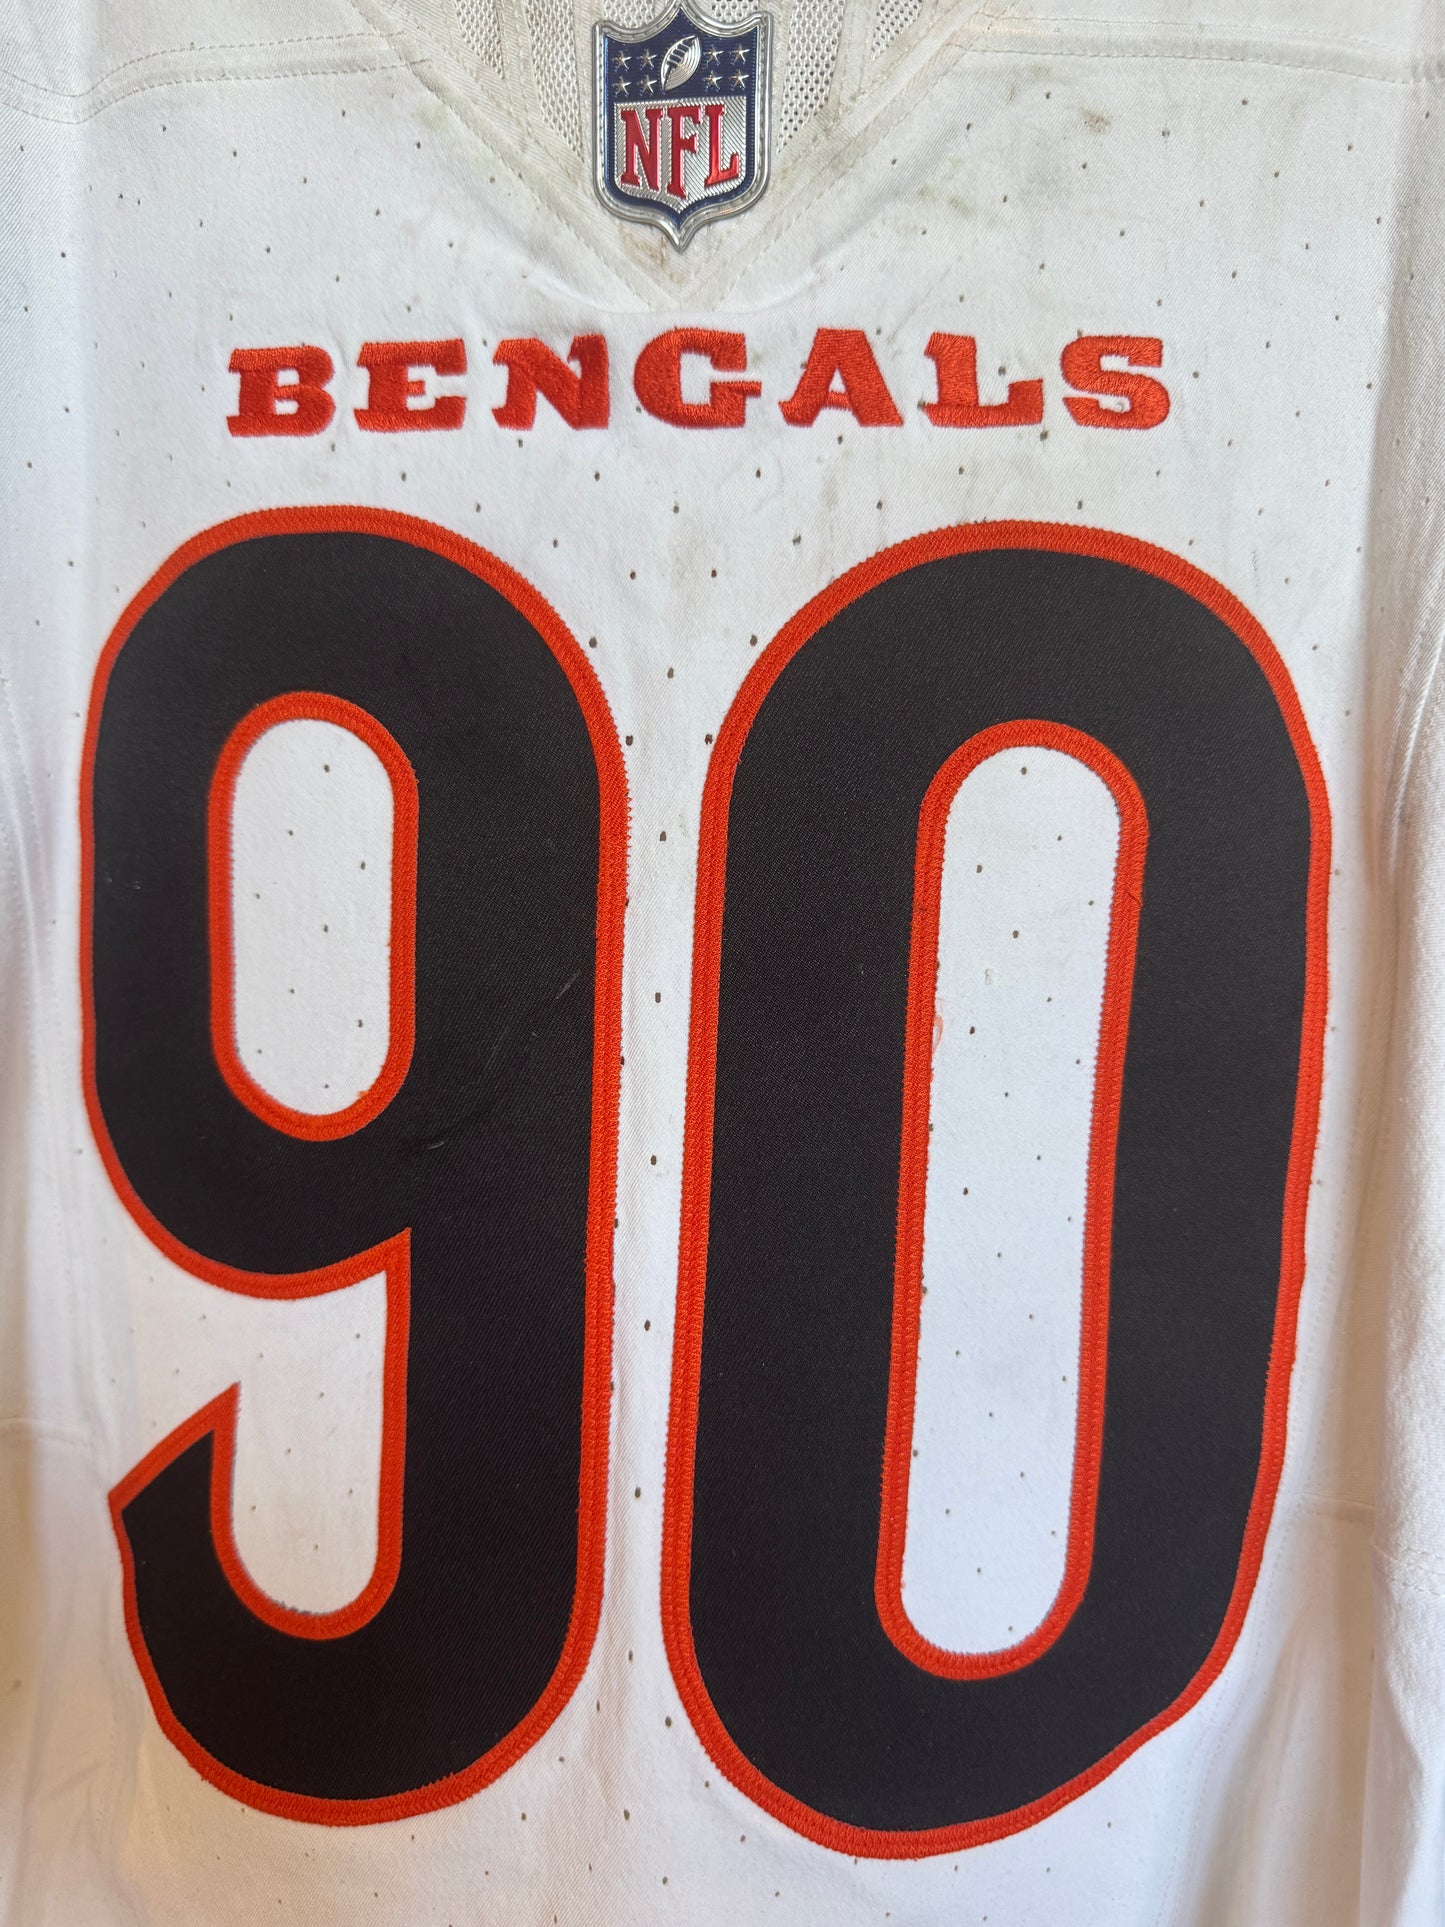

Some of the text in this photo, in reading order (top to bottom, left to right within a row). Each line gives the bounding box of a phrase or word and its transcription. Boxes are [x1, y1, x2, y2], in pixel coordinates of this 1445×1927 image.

[620, 104, 740, 199] NFL
[227, 327, 1171, 437] BENGALS
[79, 504, 1333, 1861] 90
